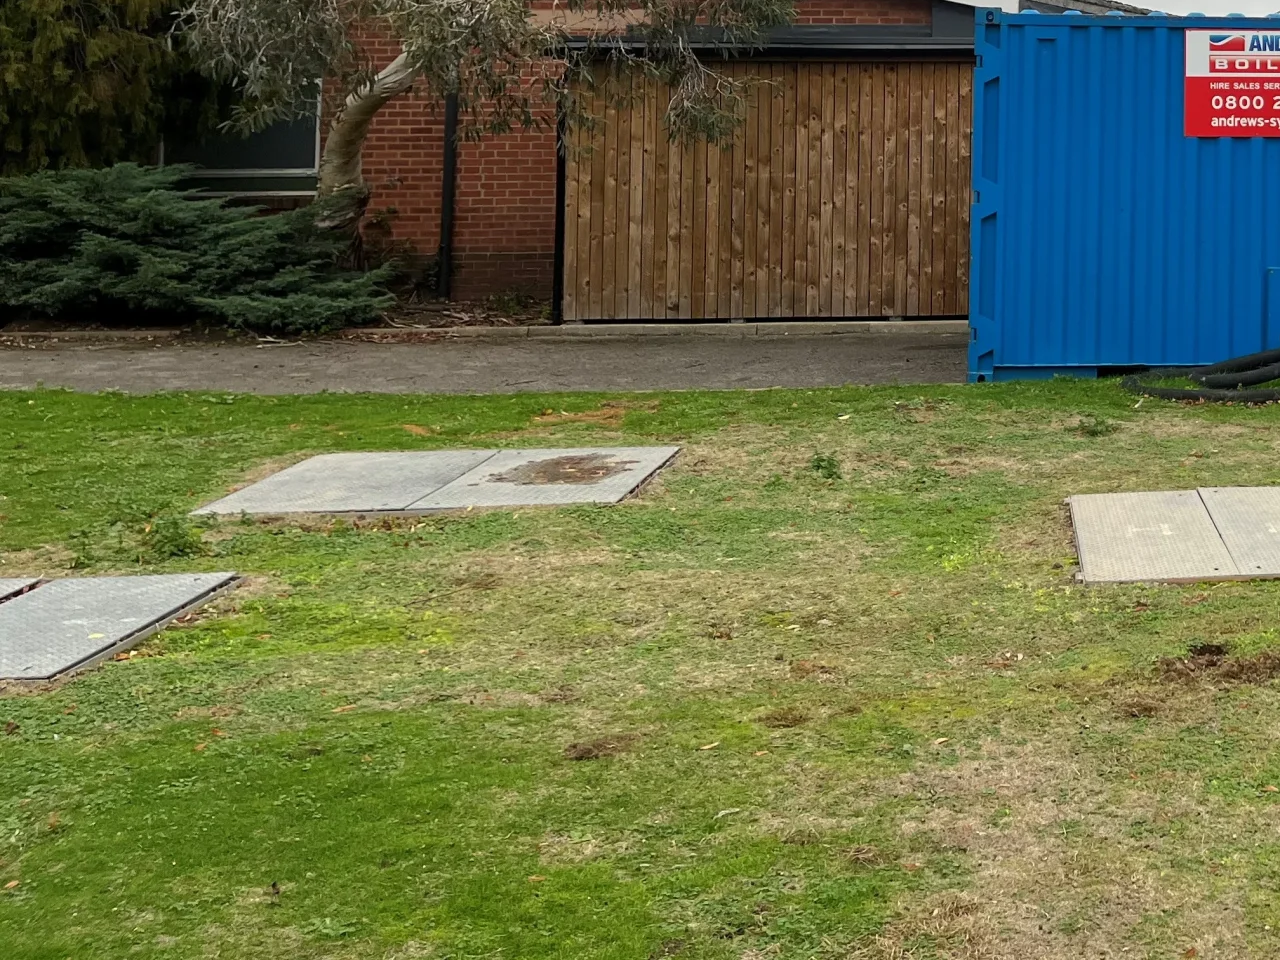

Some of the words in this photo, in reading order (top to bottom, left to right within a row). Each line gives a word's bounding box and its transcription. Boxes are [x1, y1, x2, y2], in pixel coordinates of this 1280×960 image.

[1210, 82, 1230, 90] HIRE
[1233, 82, 1260, 90] SALES
[1211, 96, 1264, 110] 0800
